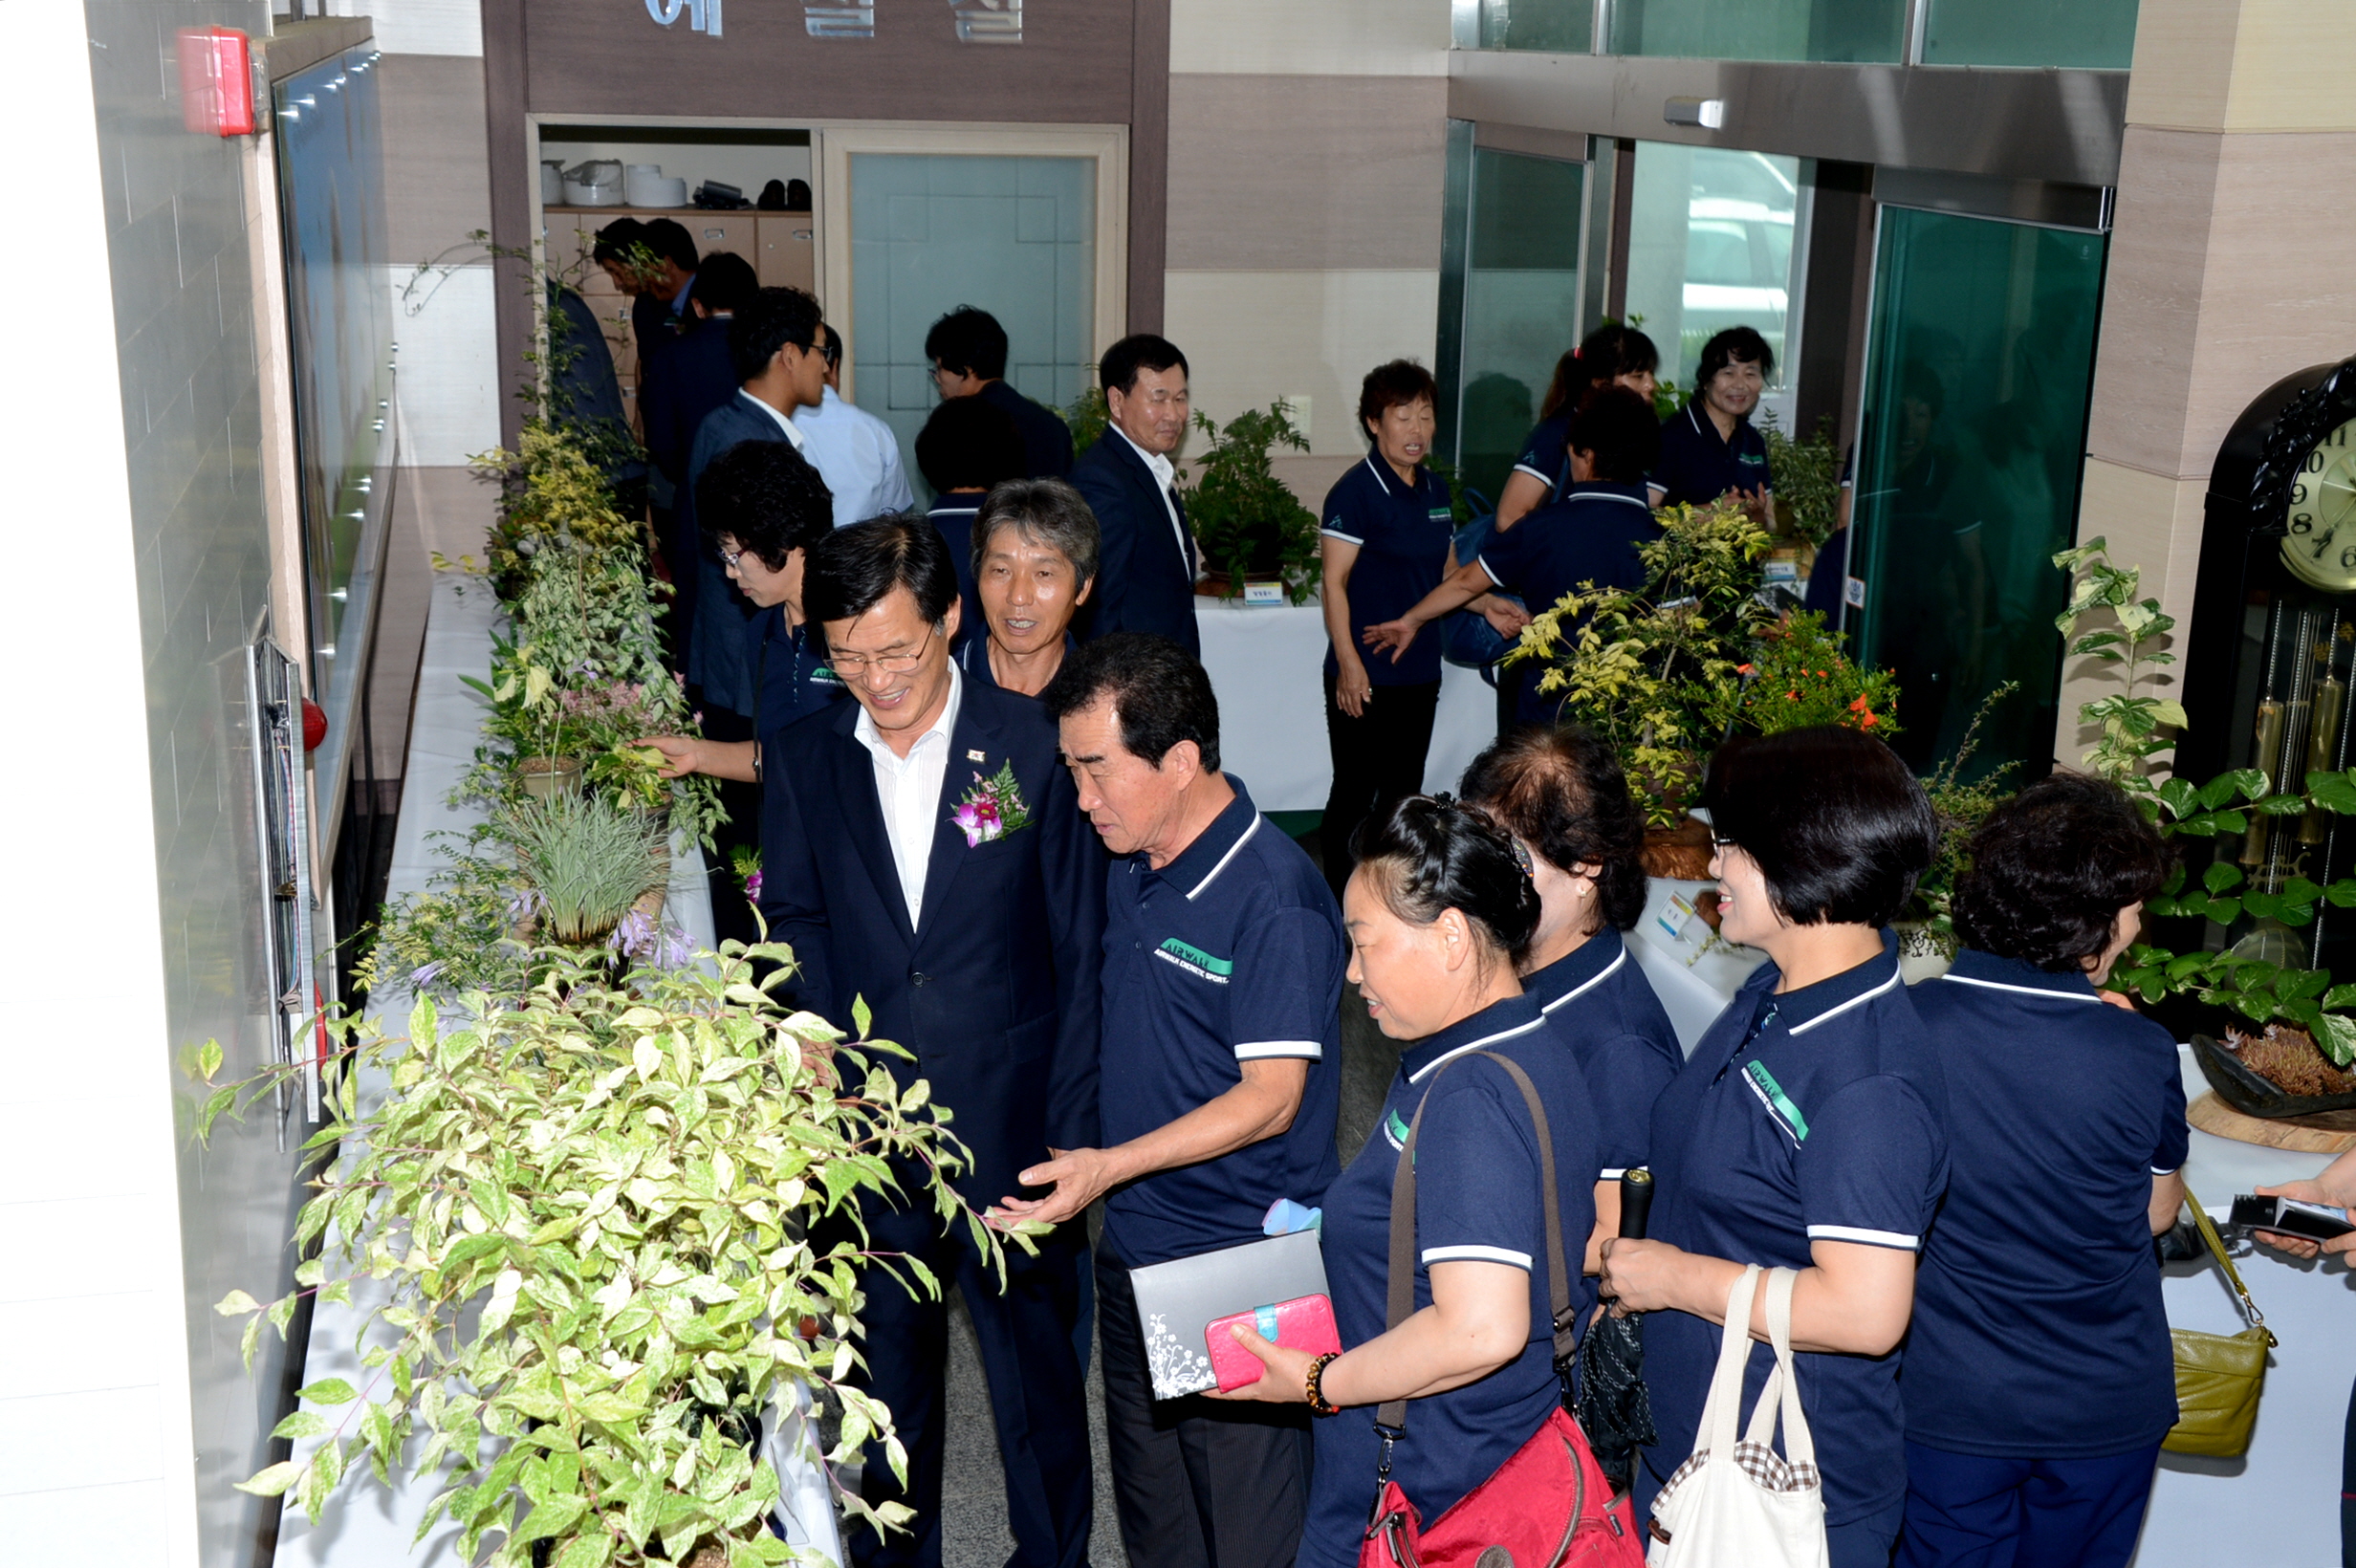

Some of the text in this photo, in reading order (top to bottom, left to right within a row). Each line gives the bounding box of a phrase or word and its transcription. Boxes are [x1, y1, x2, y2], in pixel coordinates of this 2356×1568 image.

[2291, 484, 2307, 505] 9
[2291, 513, 2312, 534] 8
[2312, 530, 2334, 558] 7
[1167, 943, 1210, 969] AIRWALK
[1749, 1065, 1779, 1100] AIRWALK
